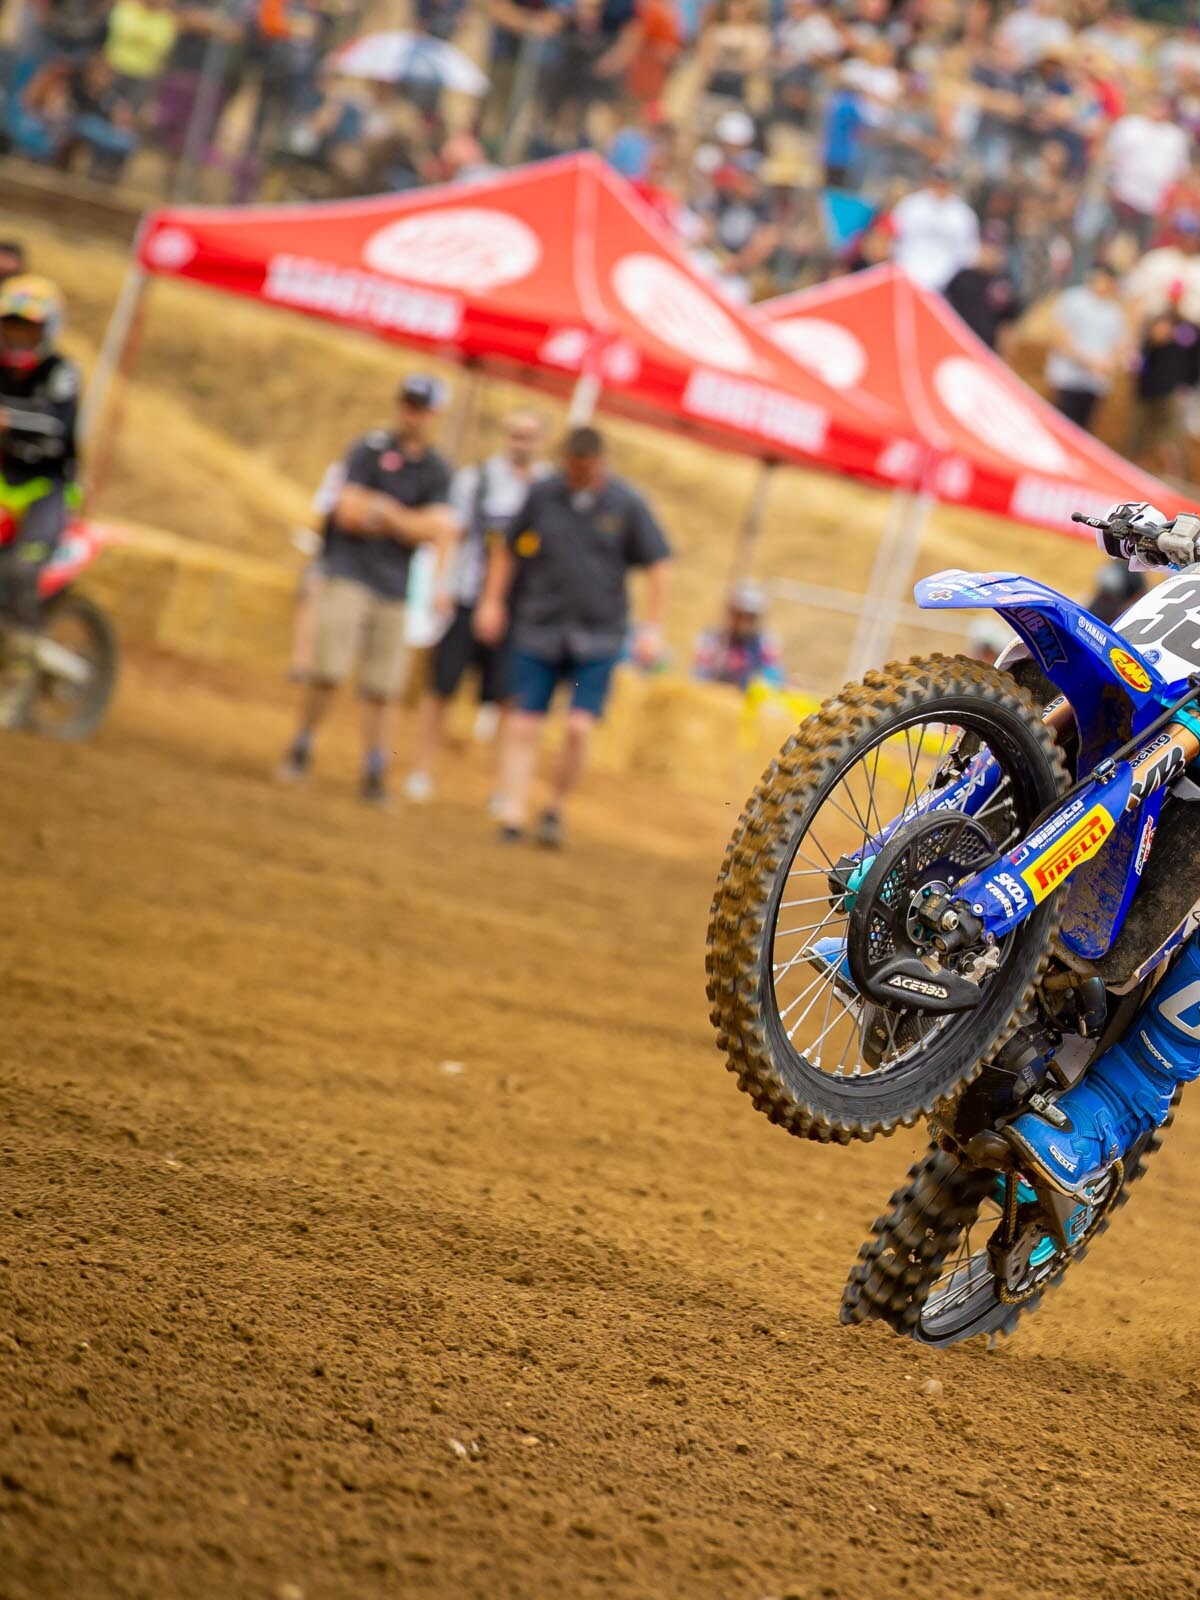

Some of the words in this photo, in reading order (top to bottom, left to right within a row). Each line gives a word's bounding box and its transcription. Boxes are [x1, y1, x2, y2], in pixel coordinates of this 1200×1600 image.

[1084, 618, 1107, 648] YAMAHA
[1114, 653, 1152, 688] FMF
[1131, 732, 1171, 769] acing
[1027, 800, 1085, 850] WISECO
[1034, 815, 1107, 891] PIRELLI
[993, 871, 1028, 912] SKDA
[888, 975, 949, 999] ACERBIS
